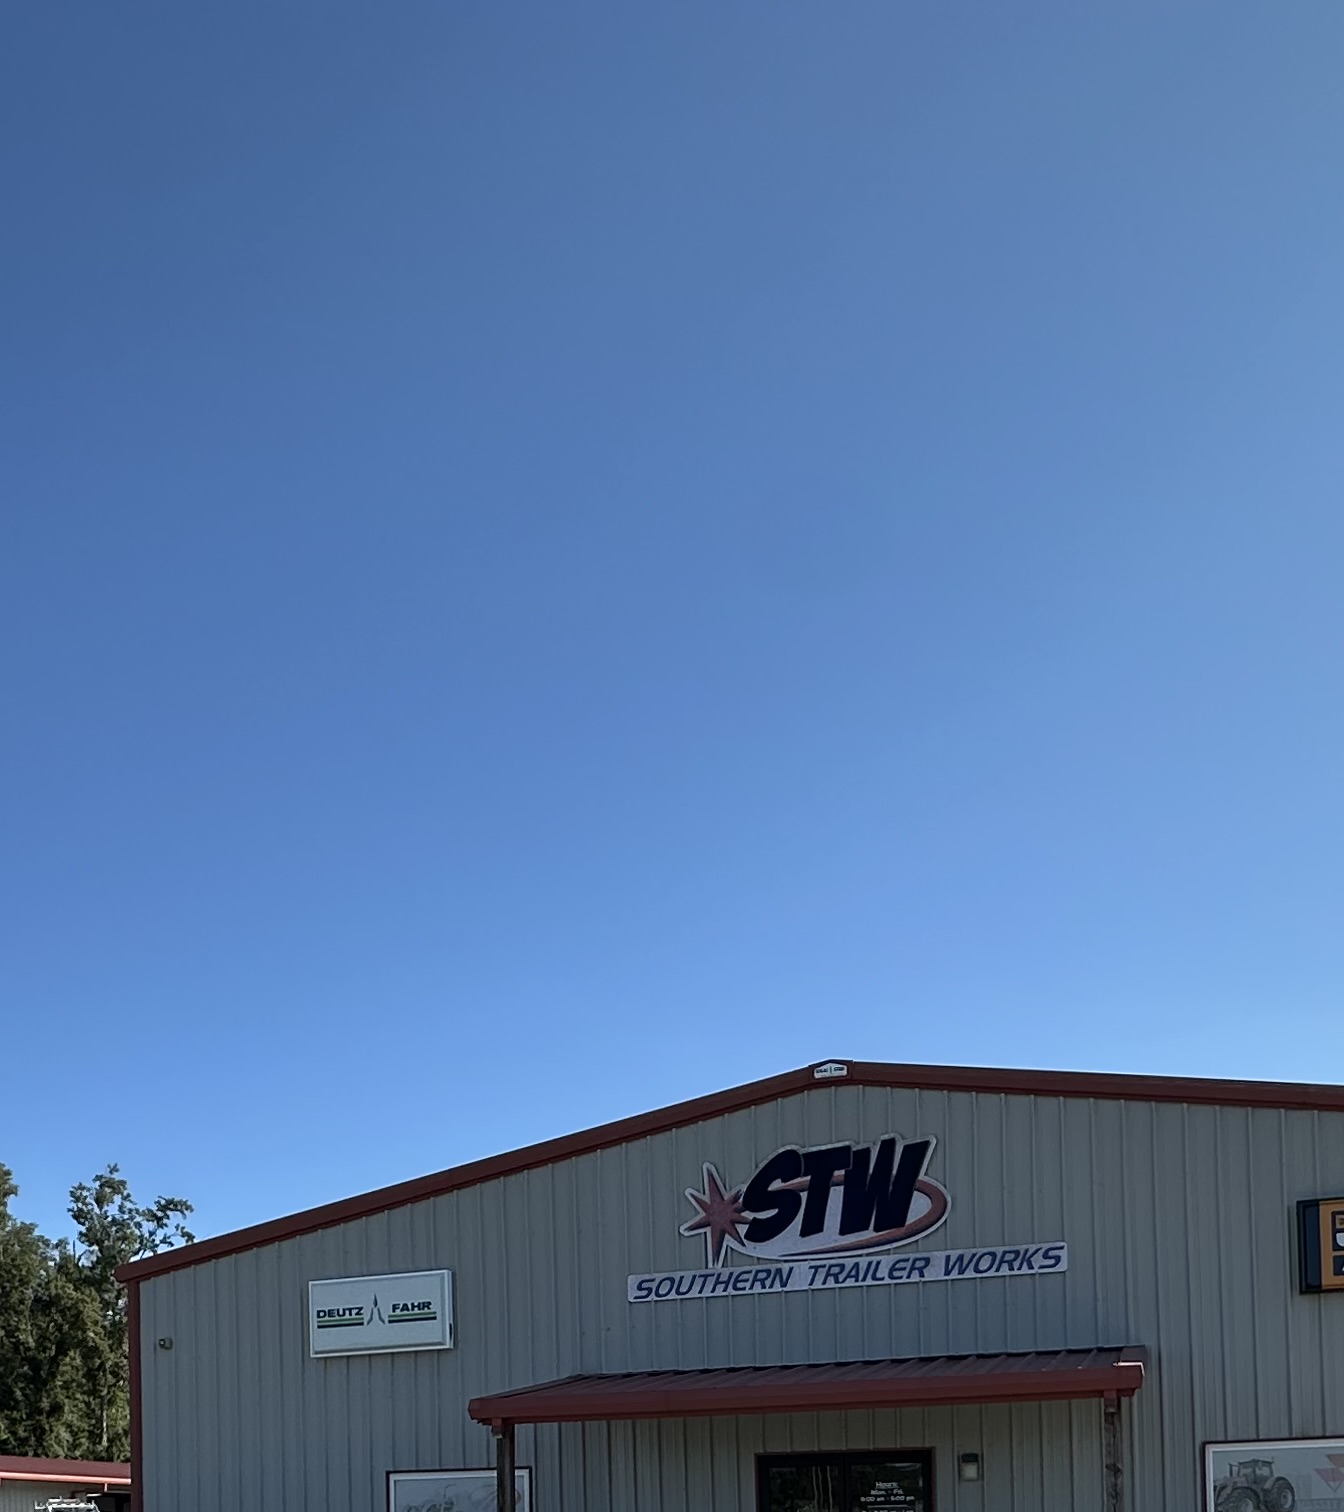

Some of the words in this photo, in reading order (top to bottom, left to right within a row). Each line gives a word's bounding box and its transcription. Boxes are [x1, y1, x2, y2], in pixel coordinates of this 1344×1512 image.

[743, 1137, 931, 1243] STW
[633, 1267, 793, 1300] SOUTHERN
[807, 1256, 931, 1287] TRAILER
[943, 1245, 1066, 1277] WORKS
[316, 1306, 364, 1319] DEUTZ
[391, 1301, 432, 1313] FAHR
